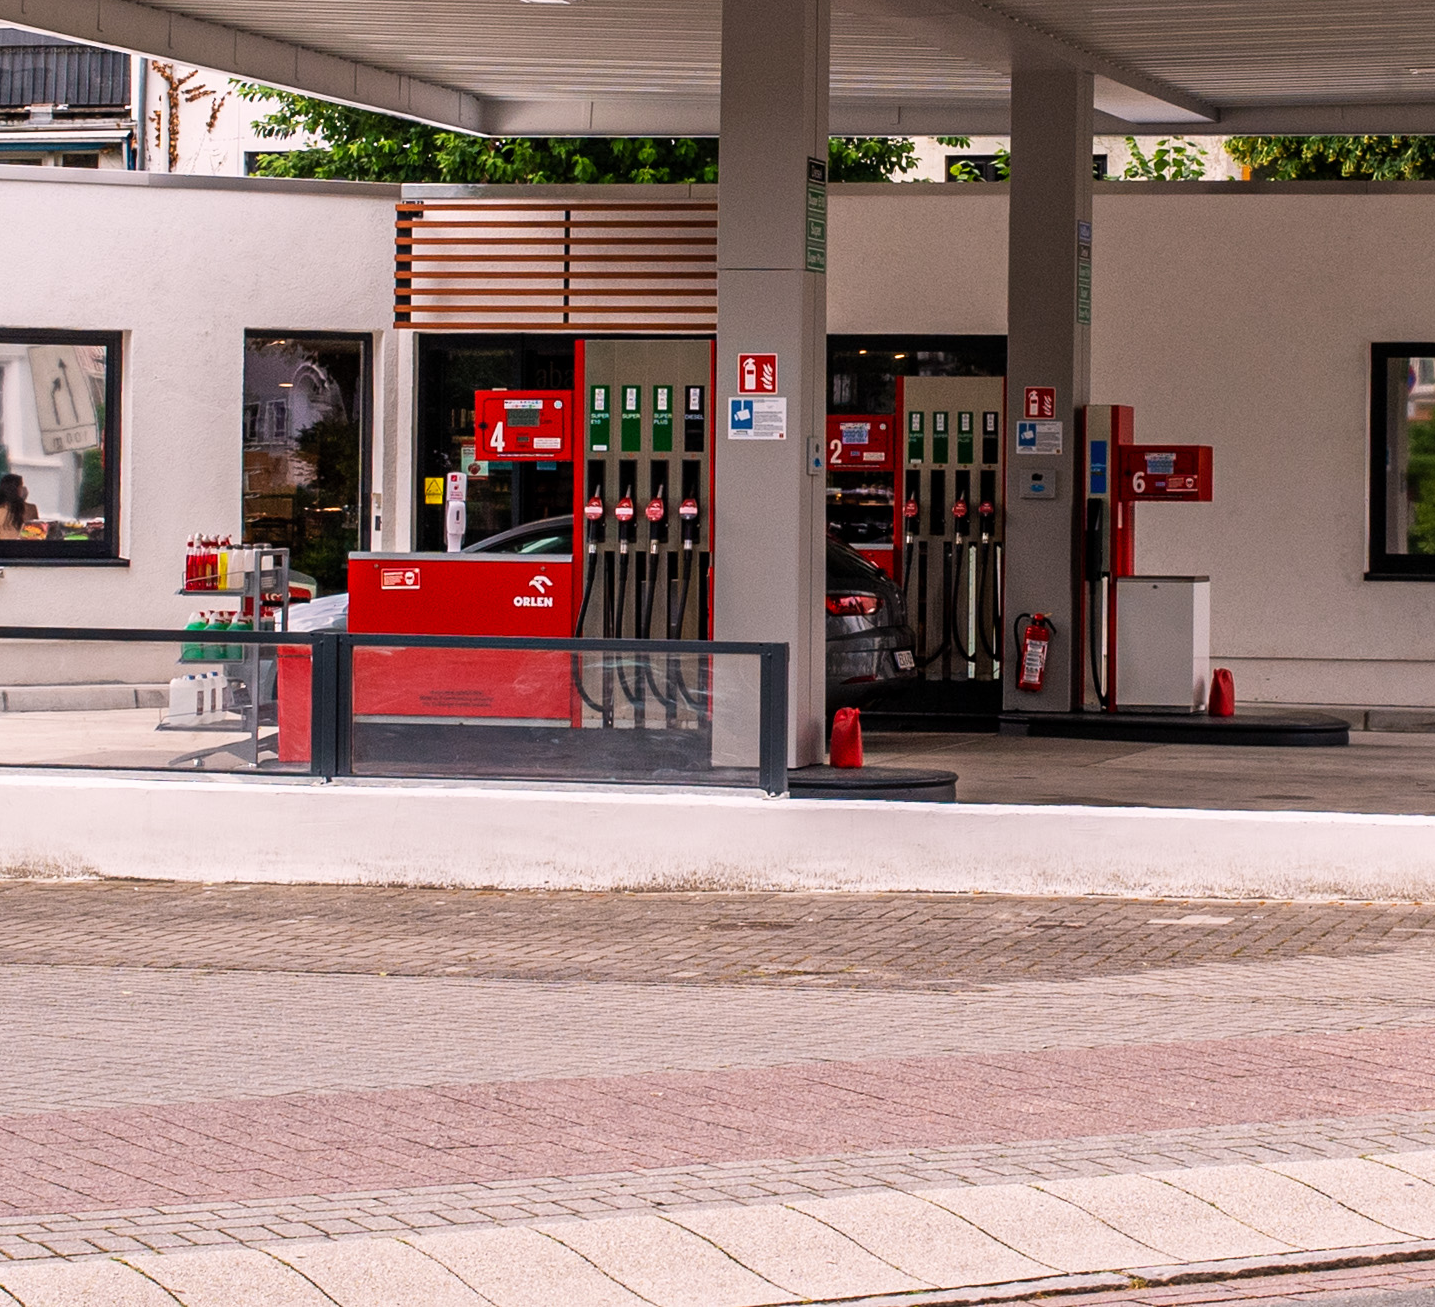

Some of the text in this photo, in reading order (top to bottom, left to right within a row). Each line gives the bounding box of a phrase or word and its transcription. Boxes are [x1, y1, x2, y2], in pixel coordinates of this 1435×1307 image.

[490, 421, 505, 452] 4
[830, 439, 842, 463] 2
[1132, 471, 1145, 493] 6
[513, 596, 554, 608] ORLEN
